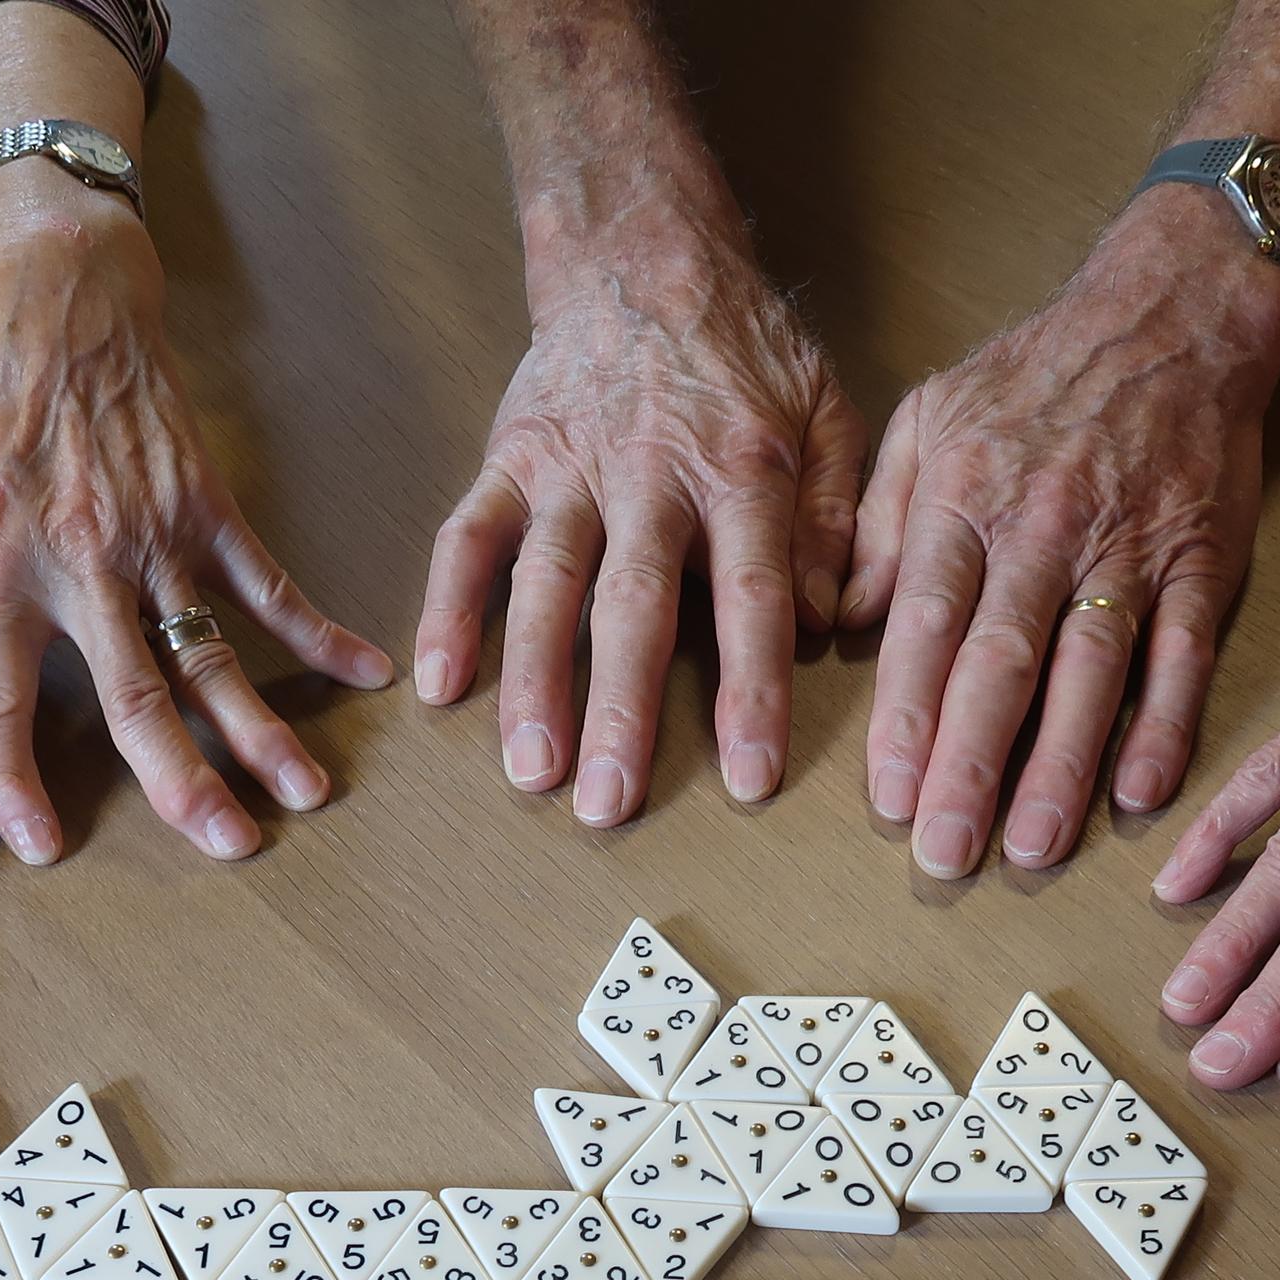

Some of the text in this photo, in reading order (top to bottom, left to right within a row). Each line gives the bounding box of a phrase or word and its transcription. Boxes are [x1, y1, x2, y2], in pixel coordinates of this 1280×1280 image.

[630, 936, 653, 958] 3
[602, 979, 631, 1000] 3
[664, 975, 694, 994] 3
[667, 1009, 696, 1031] 3
[761, 1001, 791, 1022] 3
[825, 1002, 854, 1023] 3
[1022, 1008, 1050, 1033] 0
[603, 1015, 633, 1034] 3
[727, 1022, 749, 1046] 3
[873, 1019, 895, 1042] 3
[795, 1042, 823, 1067] 0
[996, 1053, 1028, 1075] 5
[1060, 1052, 1092, 1075] 2
[755, 1066, 787, 1089] 0
[839, 1061, 869, 1084] 0
[902, 1062, 933, 1084] 5
[554, 1096, 585, 1120] 5
[850, 1099, 882, 1122] 0
[996, 1091, 1029, 1115] 5
[1061, 1088, 1095, 1111] 2
[1115, 1097, 1138, 1123] 2
[57, 1100, 85, 1126] 0
[774, 1109, 805, 1131] 0
[912, 1101, 945, 1122] 5
[963, 1115, 986, 1139] 5
[580, 1142, 603, 1168] 3
[815, 1135, 843, 1162] 0
[885, 1141, 914, 1168] 0
[1040, 1133, 1063, 1159] 5
[1087, 1144, 1120, 1167] 5
[1154, 1143, 1185, 1165] 4
[14, 1149, 44, 1167] 4
[630, 1164, 660, 1186] 3
[930, 1161, 961, 1184] 0
[995, 1159, 1027, 1183] 5
[1, 1185, 25, 1208] 4
[843, 1182, 875, 1207] 0
[1095, 1185, 1127, 1210] 5
[1159, 1184, 1189, 1201] 4
[222, 1198, 256, 1220] 5
[307, 1199, 340, 1224] 5
[372, 1198, 406, 1221] 5
[462, 1195, 494, 1220] 5
[529, 1198, 560, 1220] 3
[631, 1207, 662, 1230] 3
[268, 1222, 292, 1249] 5
[417, 1218, 441, 1245] 5
[578, 1216, 602, 1243] 3
[1140, 1229, 1163, 1255] 5
[342, 1243, 366, 1270] 5
[495, 1242, 519, 1268] 3
[662, 1254, 686, 1280] 2
